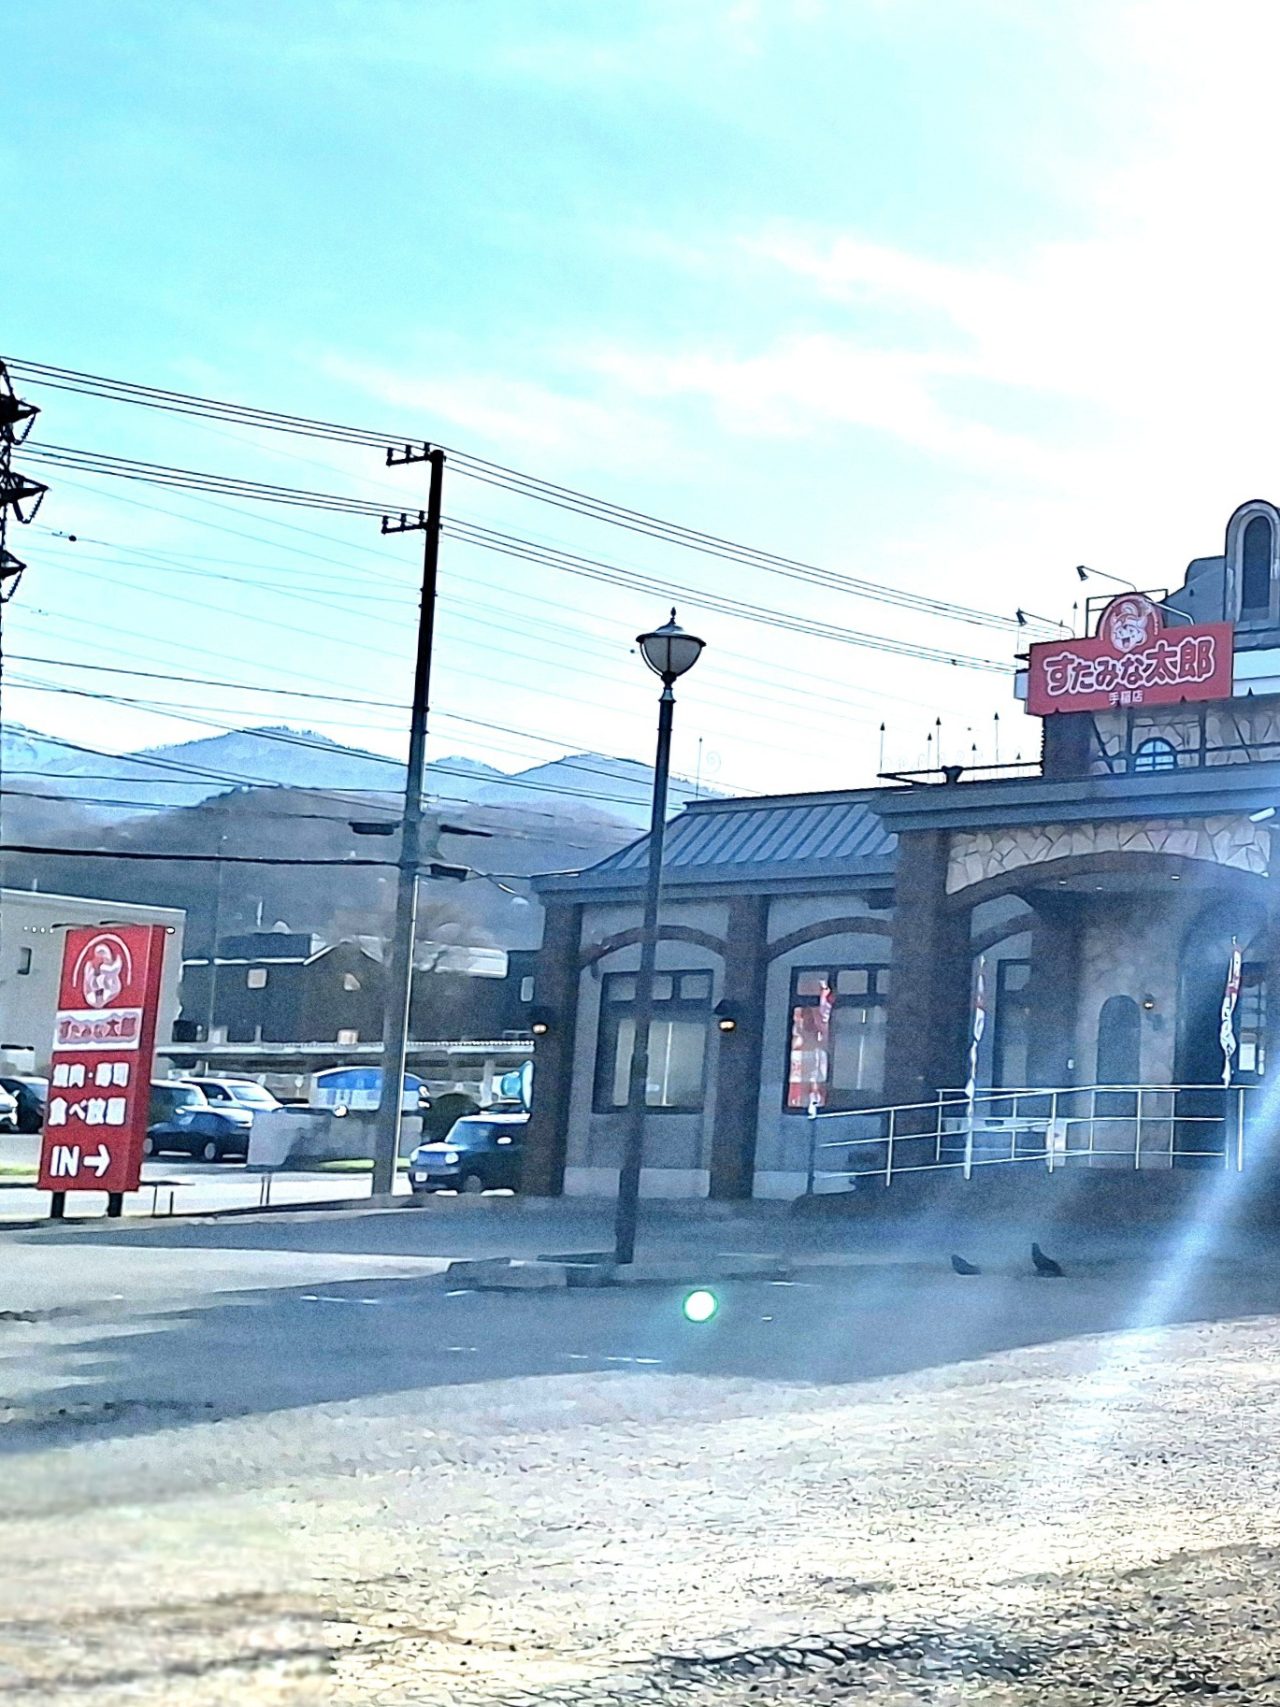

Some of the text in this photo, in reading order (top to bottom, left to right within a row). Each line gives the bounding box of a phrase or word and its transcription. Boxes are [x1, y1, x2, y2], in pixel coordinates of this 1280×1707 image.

[1044, 635, 1215, 696] すたみな太郎
[50, 1145, 80, 1177] IN
